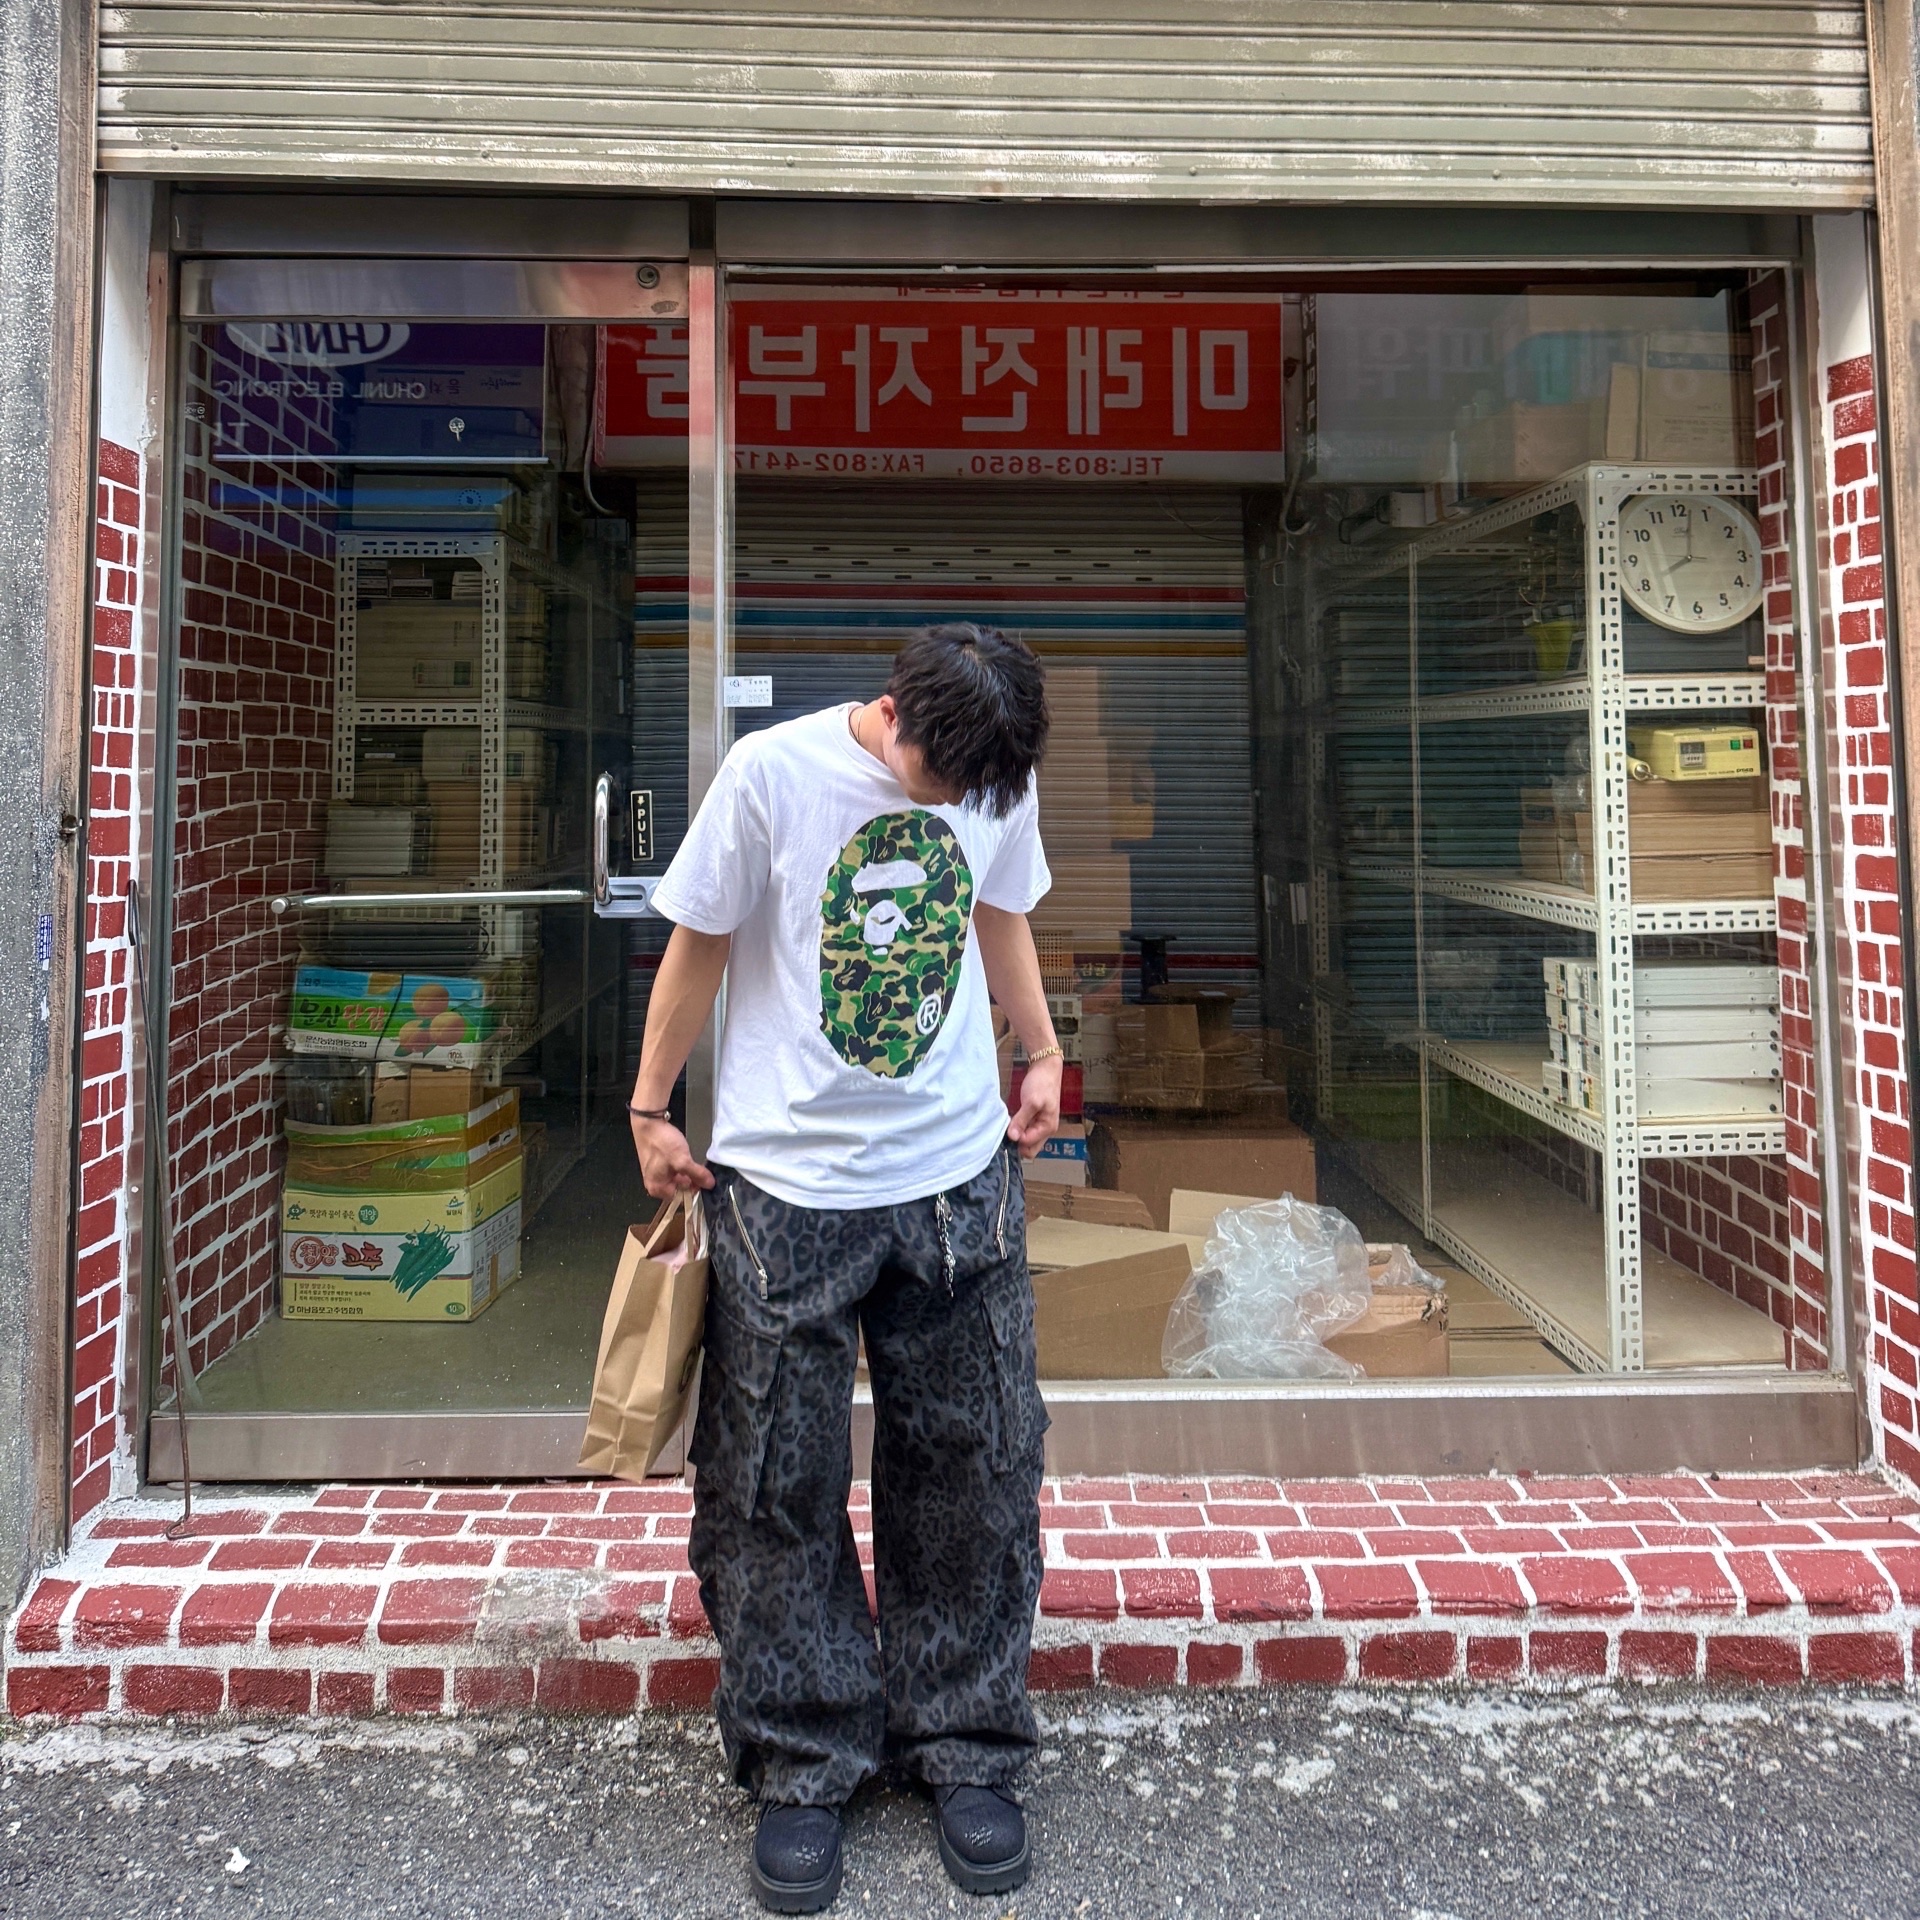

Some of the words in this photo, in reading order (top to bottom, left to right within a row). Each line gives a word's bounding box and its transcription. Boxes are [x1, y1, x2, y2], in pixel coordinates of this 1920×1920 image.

[1670, 504, 1687, 517] 12
[1702, 509, 1709, 522] 1
[1649, 511, 1664, 524] 11
[1633, 529, 1651, 542] 10
[1723, 526, 1734, 539] 2
[1628, 555, 1638, 567] 9
[1737, 550, 1748, 563] 3
[1641, 578, 1651, 592] 8
[1734, 575, 1744, 588] 4
[1665, 595, 1675, 609] 7
[1719, 593, 1729, 606] 5
[1693, 601, 1703, 614] 6
[637, 808, 647, 856] PULL
